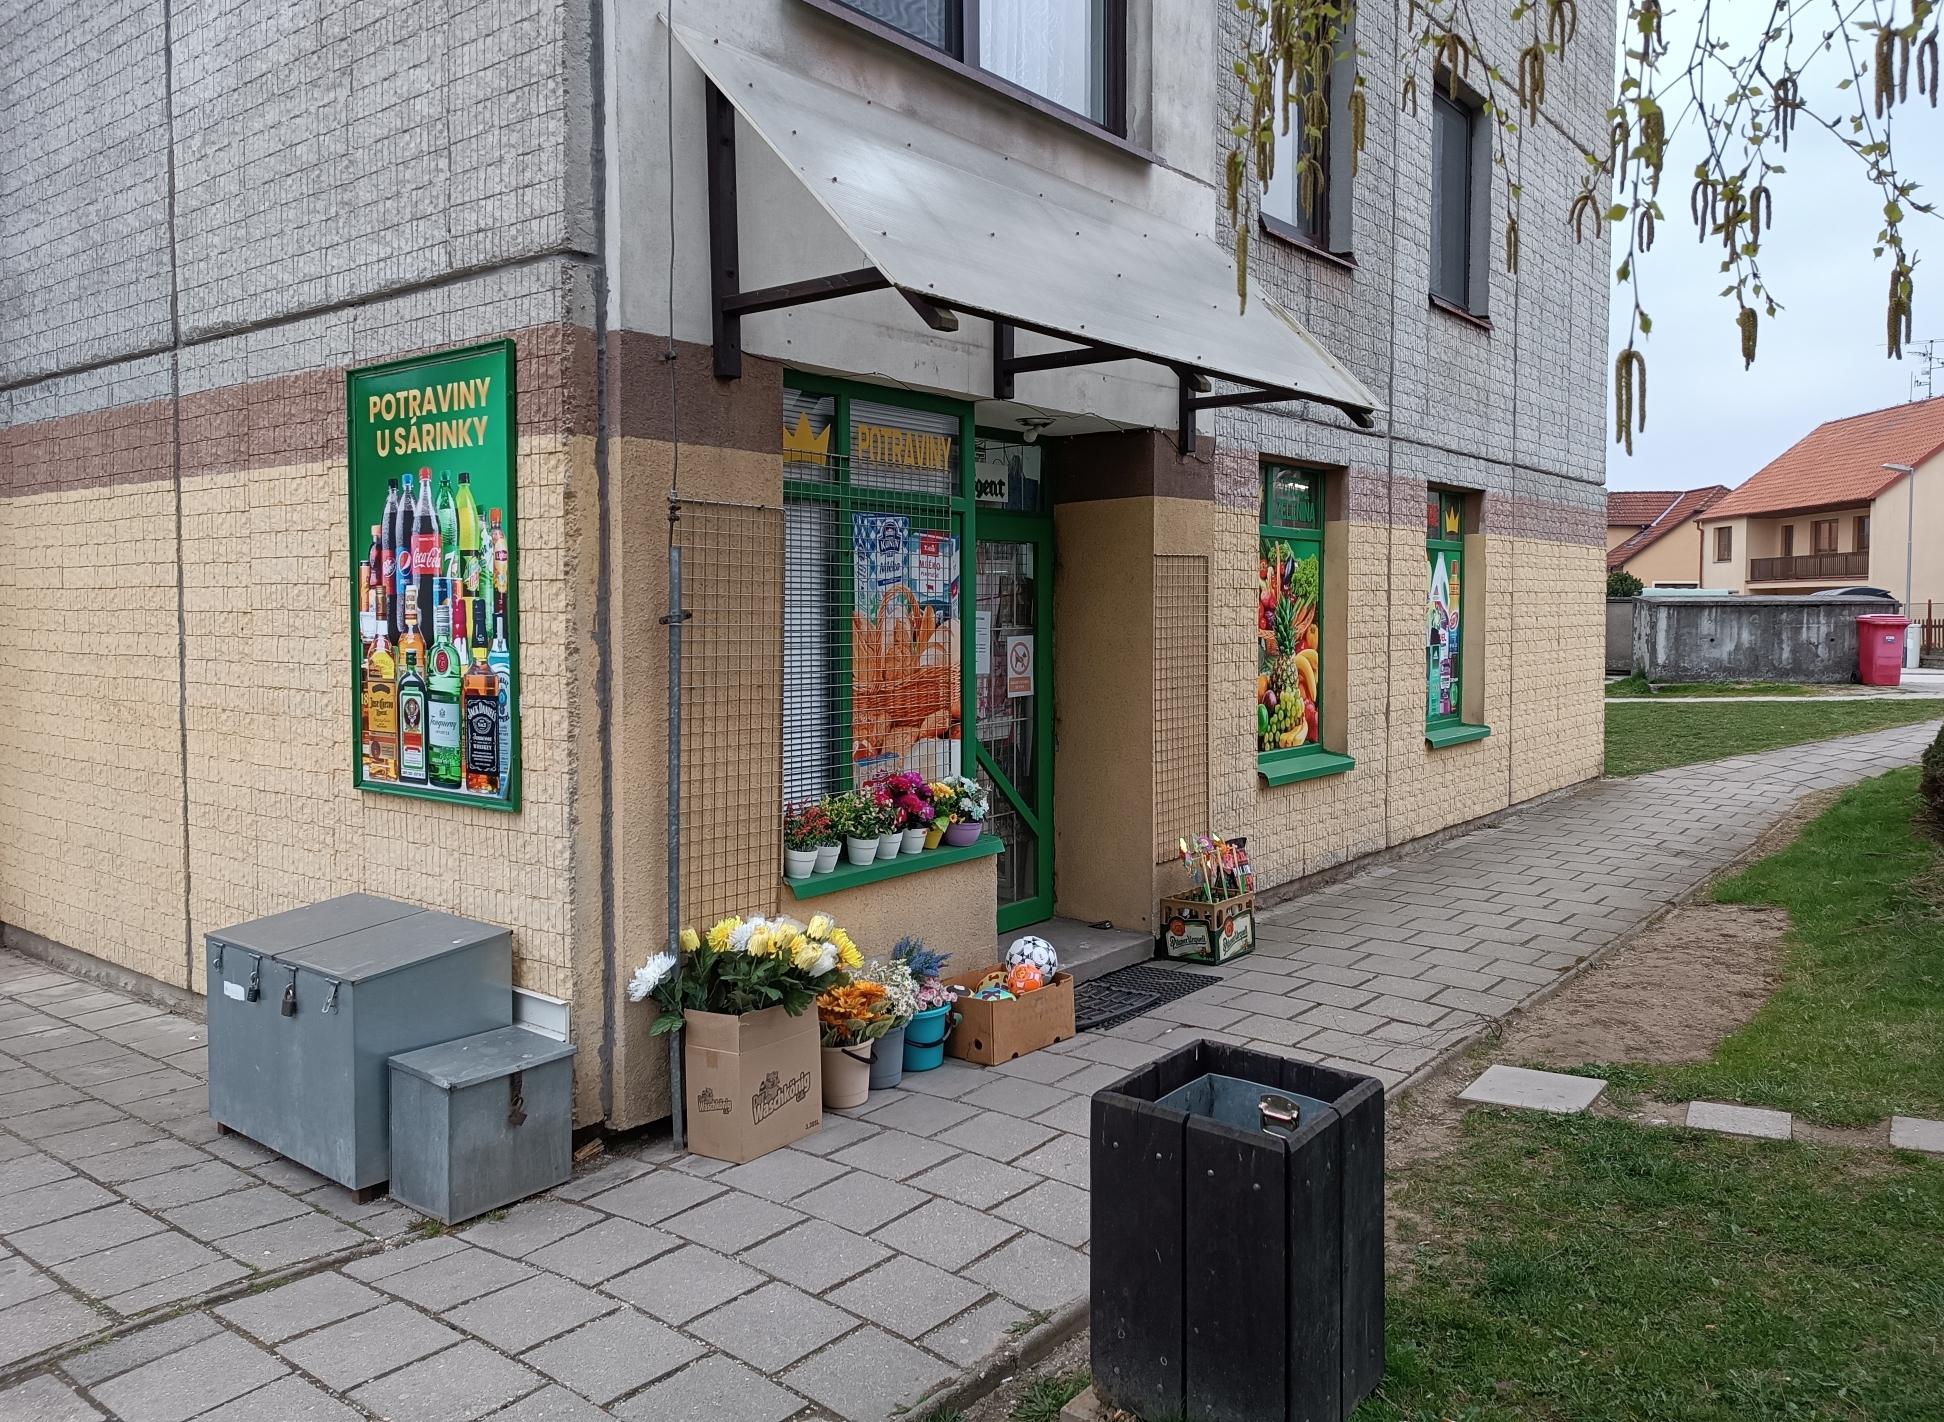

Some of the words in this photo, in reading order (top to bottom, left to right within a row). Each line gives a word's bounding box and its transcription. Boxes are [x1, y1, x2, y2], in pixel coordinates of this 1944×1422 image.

[369, 377, 491, 423] POTRAVINY
[376, 429, 390, 458] U
[394, 415, 488, 455] SÁRINKY
[858, 424, 952, 471] POTRAVINY
[975, 478, 1006, 498] gent
[467, 705, 480, 721] JACK
[753, 1073, 811, 1124] Waschkönig
